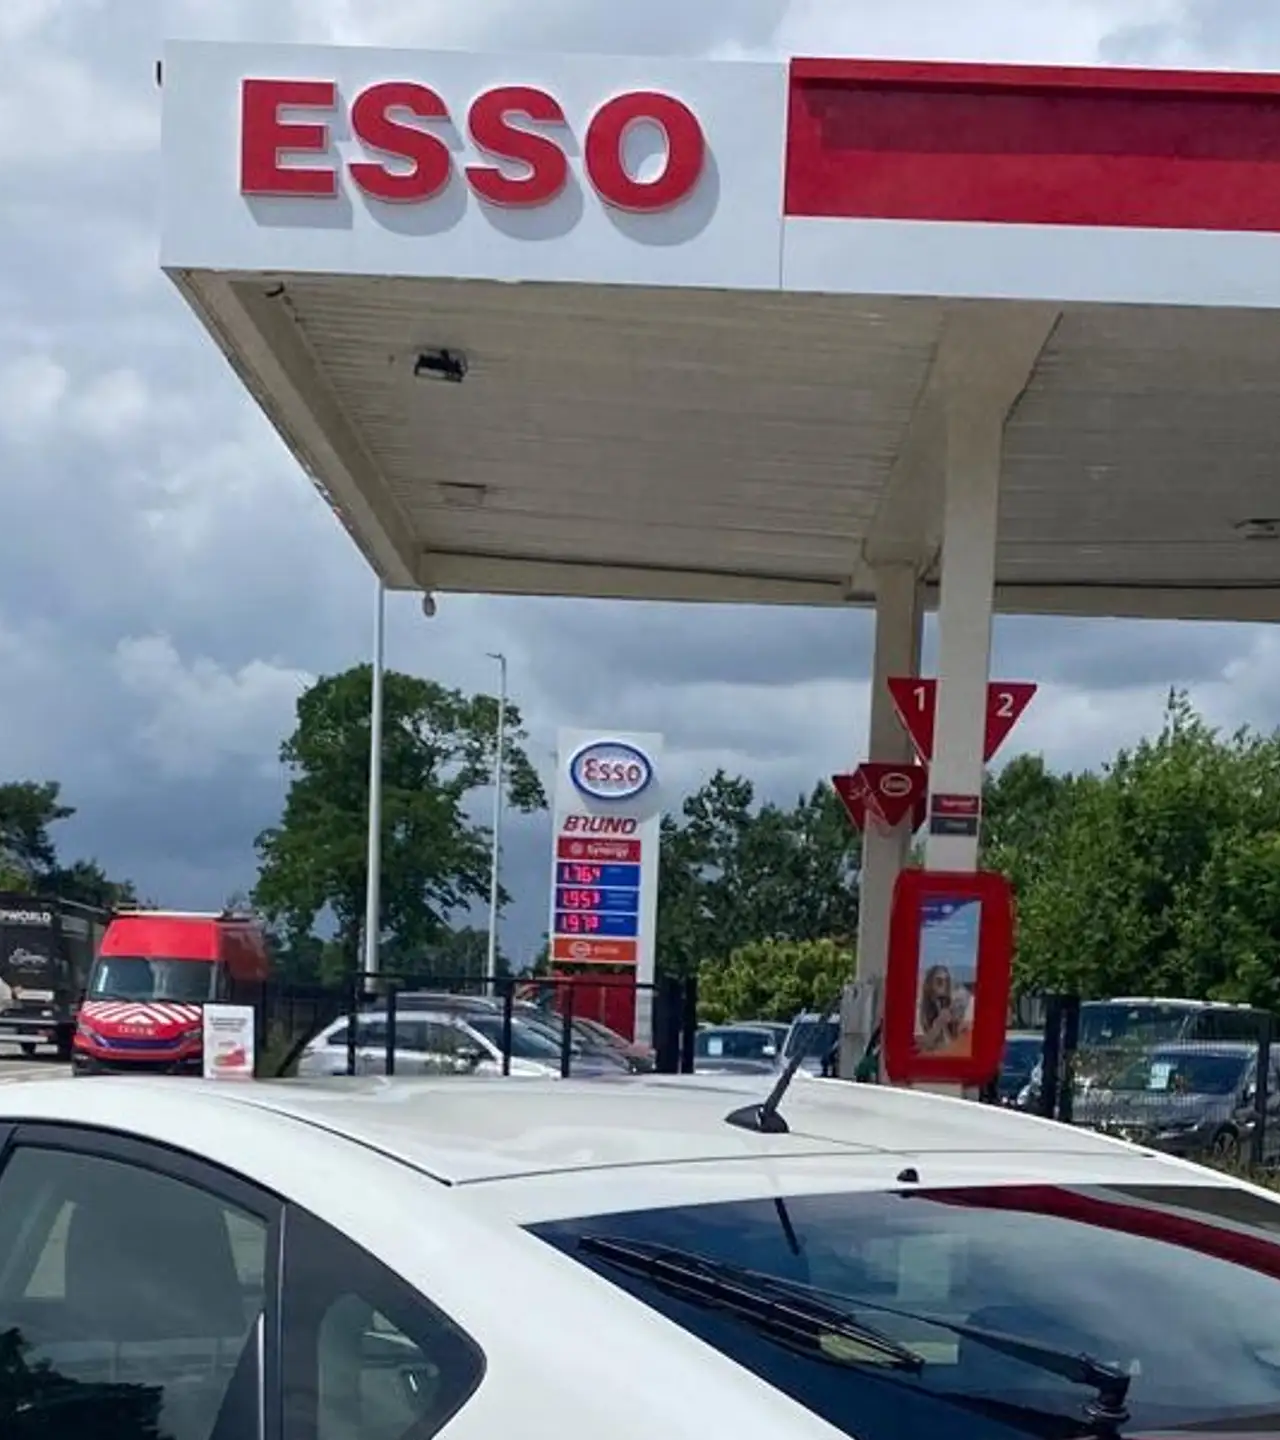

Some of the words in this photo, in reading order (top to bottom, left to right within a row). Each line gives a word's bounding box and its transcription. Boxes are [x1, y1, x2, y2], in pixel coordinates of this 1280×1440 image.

[240, 77, 706, 213] ESSO
[913, 686, 926, 712] 1
[996, 693, 1014, 717] 2
[584, 758, 641, 784] Esso
[563, 815, 637, 834] BRUNO
